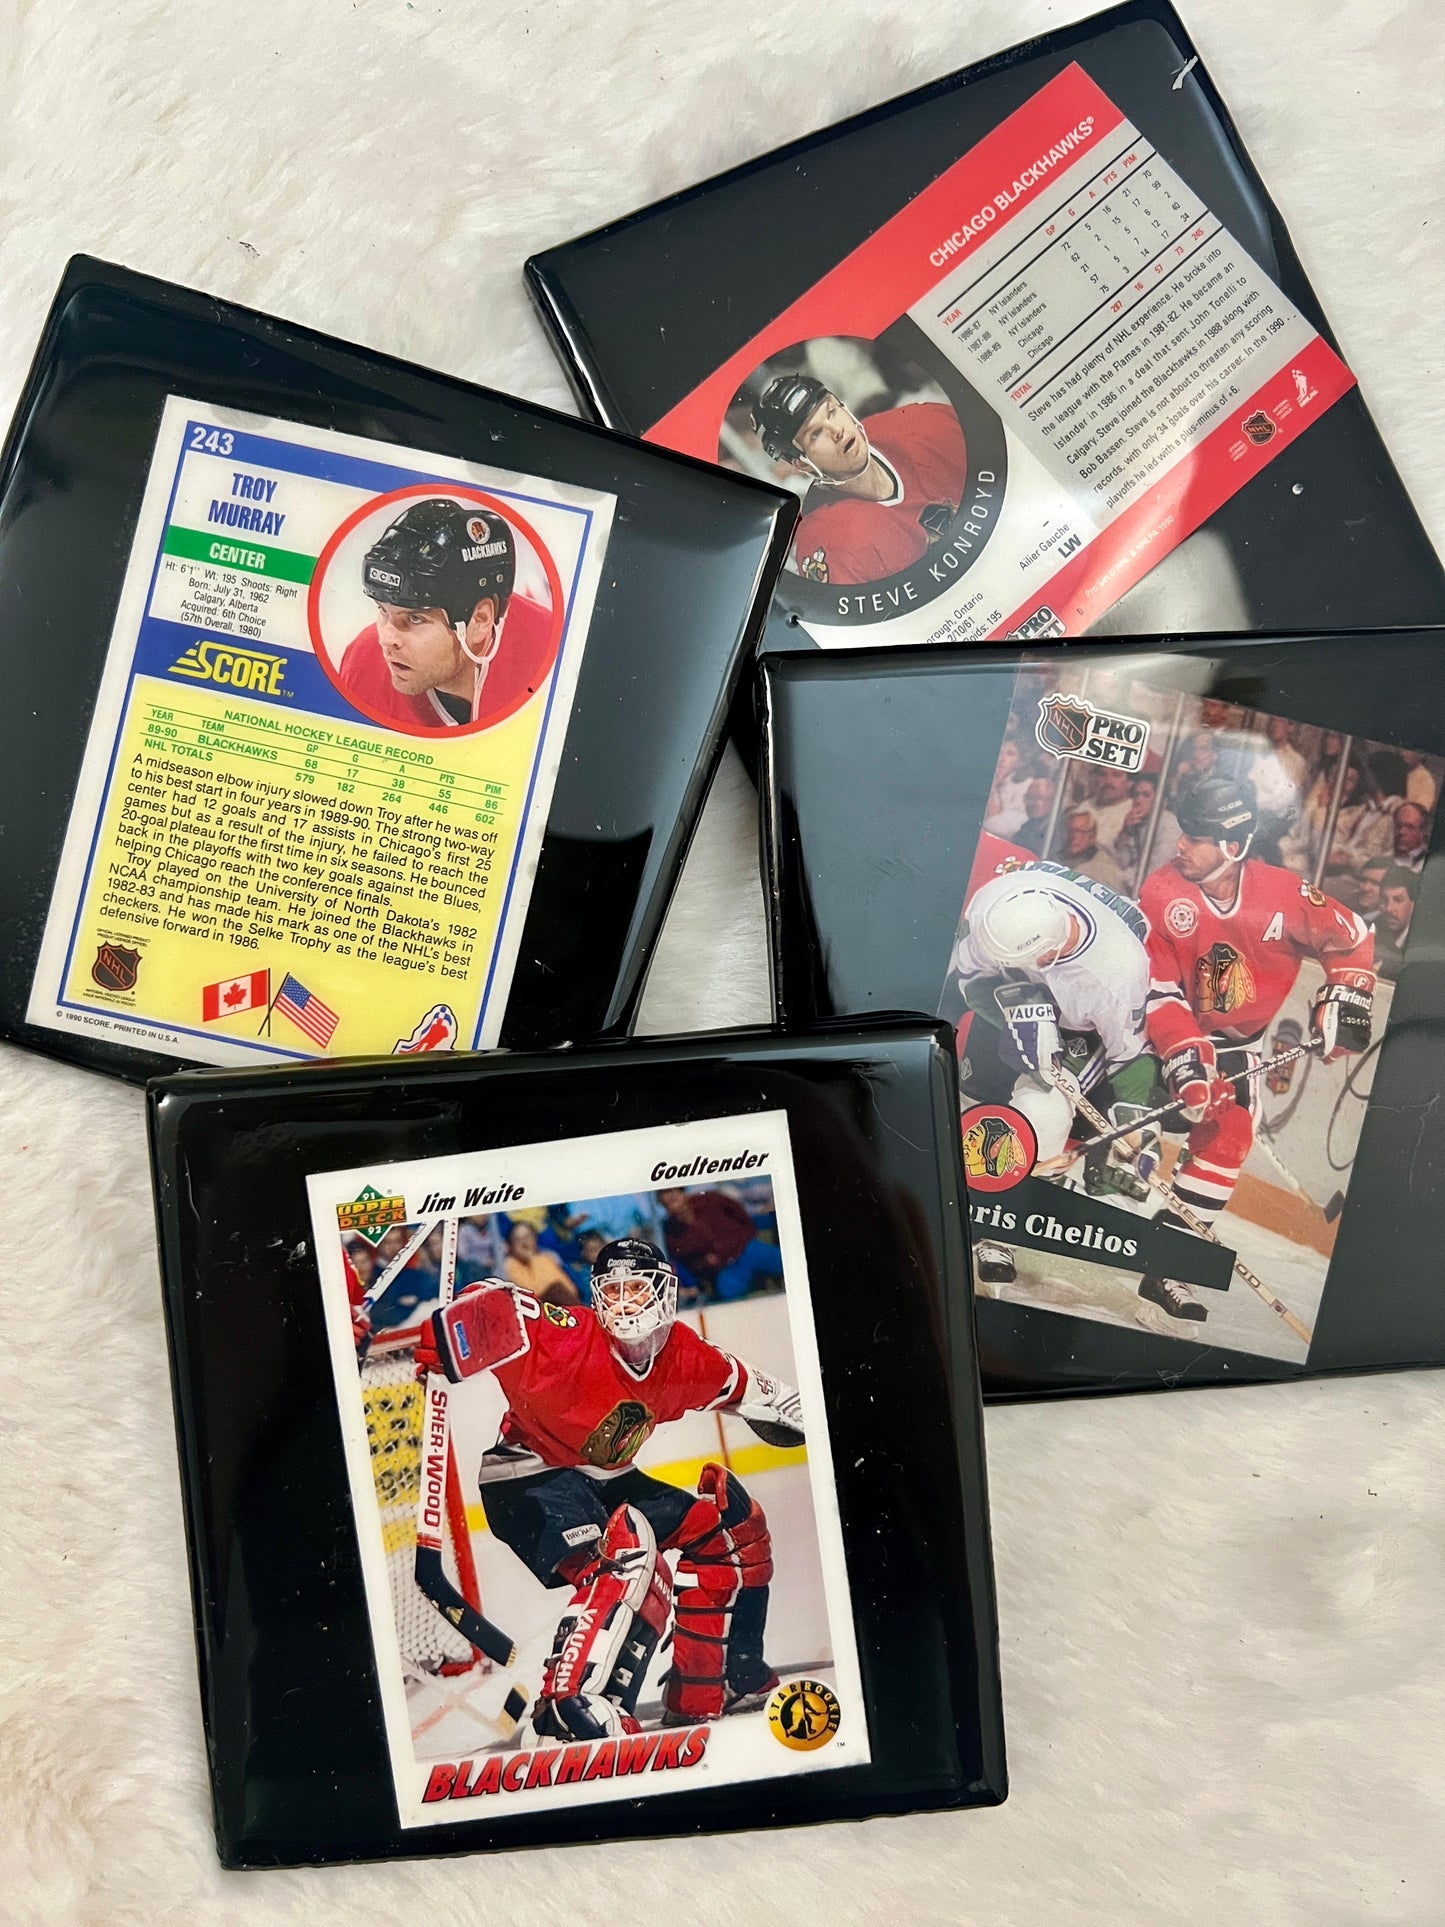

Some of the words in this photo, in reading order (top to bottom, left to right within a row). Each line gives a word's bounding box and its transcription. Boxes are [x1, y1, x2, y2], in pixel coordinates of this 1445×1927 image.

[929, 206, 996, 266] CHICAGO
[993, 116, 1094, 210] BLACKHAWKS®
[942, 308, 962, 326] YEAR
[1045, 224, 1055, 236] GP
[1067, 208, 1075, 216] G
[1102, 170, 1117, 185] PTS
[1122, 153, 1137, 168] PIM
[1027, 400, 1051, 421] Steve
[1049, 387, 1066, 402] has
[1064, 371, 1082, 388] had
[1081, 352, 1105, 376] plenty
[1104, 342, 1114, 354] of
[1112, 328, 1132, 346] NHL
[1130, 293, 1173, 331] experience.
[1170, 281, 1184, 293] He
[1183, 262, 1206, 282] broke
[1204, 248, 1221, 263] into
[190, 426, 234, 455] 243
[231, 472, 278, 502] TROY
[207, 499, 286, 536] MURRAY
[209, 542, 266, 569] CENTER
[462, 540, 506, 562] BLACKHAWKS
[838, 582, 918, 614] STEVE
[928, 470, 995, 582] KONROYD
[1019, 549, 1040, 570] Ailier
[1038, 524, 1069, 551] Gauche
[1057, 533, 1081, 558] LW
[165, 560, 177, 571] Ht:
[204, 569, 218, 580] Wt:
[222, 573, 237, 584] 195
[240, 577, 273, 592] Shoots:
[275, 584, 297, 598] Right
[188, 577, 211, 591] Born:
[213, 583, 231, 596] July
[232, 587, 245, 599] 31,
[250, 591, 269, 603] 1962
[370, 567, 400, 586] CCM
[180, 599, 219, 616] Acquired:
[222, 608, 236, 619] 6th
[238, 612, 266, 626] Choice
[193, 590, 225, 607] Calgary,
[228, 598, 258, 613] Alberta
[954, 592, 984, 619] Ontario
[180, 611, 202, 624] (57th
[204, 616, 234, 632] Overall,
[239, 624, 261, 638] 1980)
[948, 616, 976, 642] 2/10/61
[987, 610, 1002, 626] 195
[1018, 608, 1052, 636] PRO
[168, 640, 288, 696] SCORE
[224, 710, 281, 731] NATIONAL
[284, 723, 333, 742] HOCKEY
[335, 735, 382, 753] LEAGUE
[384, 746, 433, 764] RECORD
[1052, 712, 1076, 742] NHL
[1091, 716, 1142, 744] PRO
[147, 723, 177, 738] 89-90
[197, 734, 278, 760] BLACKHAWKS
[304, 758, 318, 769] 68
[347, 768, 359, 778] 17
[391, 778, 405, 789] 38
[438, 788, 451, 799] 55
[484, 799, 498, 809] 86
[152, 708, 173, 721] YEAR
[201, 719, 224, 732] TEAM
[306, 743, 318, 752] GP
[352, 753, 358, 762] G
[399, 764, 405, 773] A
[439, 773, 455, 784] PTS
[484, 783, 501, 794] PIM
[1086, 738, 1138, 766] SET
[144, 738, 167, 751] NHL
[171, 743, 213, 761] TOTALS
[295, 772, 314, 784] 579
[337, 782, 355, 793] 182
[381, 791, 401, 803] 264
[428, 802, 448, 814] 446
[475, 812, 495, 824] 602
[131, 767, 142, 778] to
[145, 769, 163, 783] his
[166, 774, 192, 790] best
[195, 783, 223, 797] start
[225, 787, 236, 800] in
[240, 790, 265, 805] four
[266, 799, 301, 814] years
[304, 804, 315, 817] in
[320, 809, 370, 830] 1989-90.
[375, 820, 399, 836] The
[401, 829, 441, 848] strong
[444, 837, 495, 859] two-way
[133, 753, 142, 764] A
[145, 757, 213, 780] midseason
[216, 772, 253, 788] elbow
[256, 779, 290, 799] injury
[292, 789, 337, 807] slowed
[339, 799, 373, 816] down
[377, 806, 402, 824] Troy
[404, 814, 433, 828] after
[435, 819, 451, 833] he
[454, 826, 478, 839] was
[481, 832, 498, 843] off
[115, 835, 161, 857] helping
[165, 846, 216, 868] Chicago
[220, 861, 255, 876] reach
[259, 868, 279, 881] the
[282, 875, 352, 897] conference
[356, 888, 392, 906] finals.
[1262, 912, 1284, 941] A
[103, 950, 127, 984] NHL
[66, 1012, 82, 1022] 1990
[83, 1016, 112, 1028] SCORE.
[113, 1023, 147, 1036] PRINTED
[147, 1030, 156, 1038] IN
[157, 1033, 179, 1044] U.S.A.
[650, 1150, 769, 1182] Goaltender
[338, 1197, 405, 1216] UPPER
[362, 1192, 376, 1200] 91
[417, 1192, 456, 1215] Jim
[464, 1183, 525, 1208] Waite
[368, 1226, 382, 1235] 92
[968, 1204, 1017, 1230] ris
[1025, 1214, 1138, 1256] Chelios
[556, 1608, 598, 1692] VAUGHN
[769, 1684, 797, 1721] STAR
[805, 1682, 839, 1732] ROOKIE
[422, 1727, 710, 1803] BLACKHAWKS
